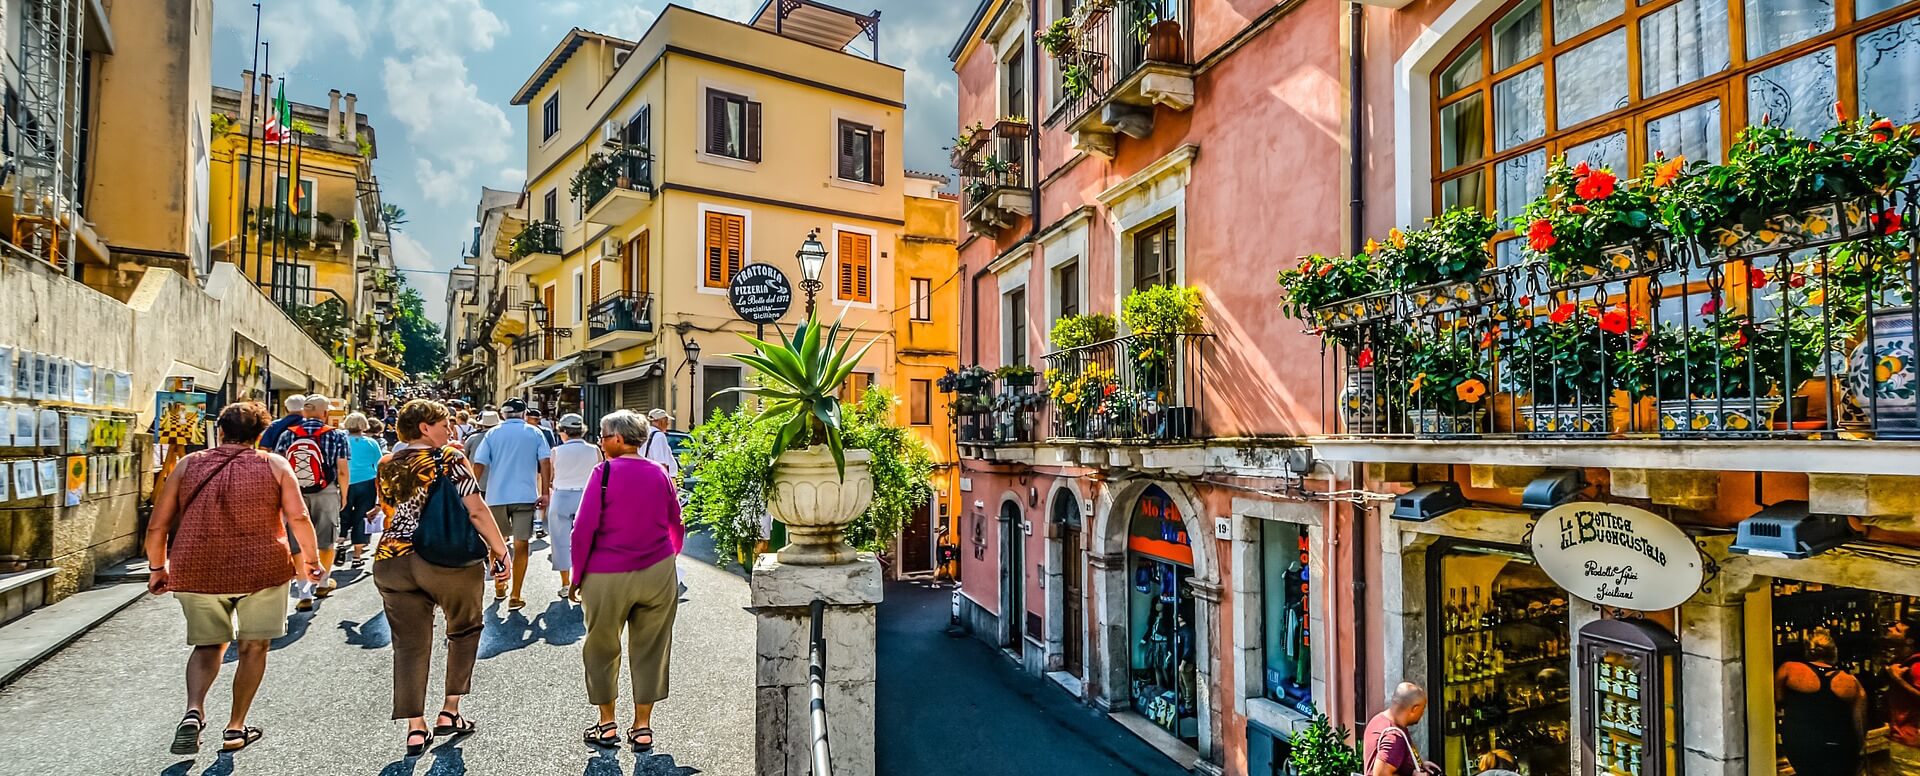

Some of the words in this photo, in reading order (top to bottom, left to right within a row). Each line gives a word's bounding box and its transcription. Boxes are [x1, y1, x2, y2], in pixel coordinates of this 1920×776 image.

[736, 265, 782, 285] TRATTORIA
[735, 285, 769, 295] PIZZERIA
[736, 296, 746, 306] La
[1559, 517, 1573, 532] La
[1584, 560, 1616, 577] Prodotti
[1597, 583, 1634, 601] Siciliani
